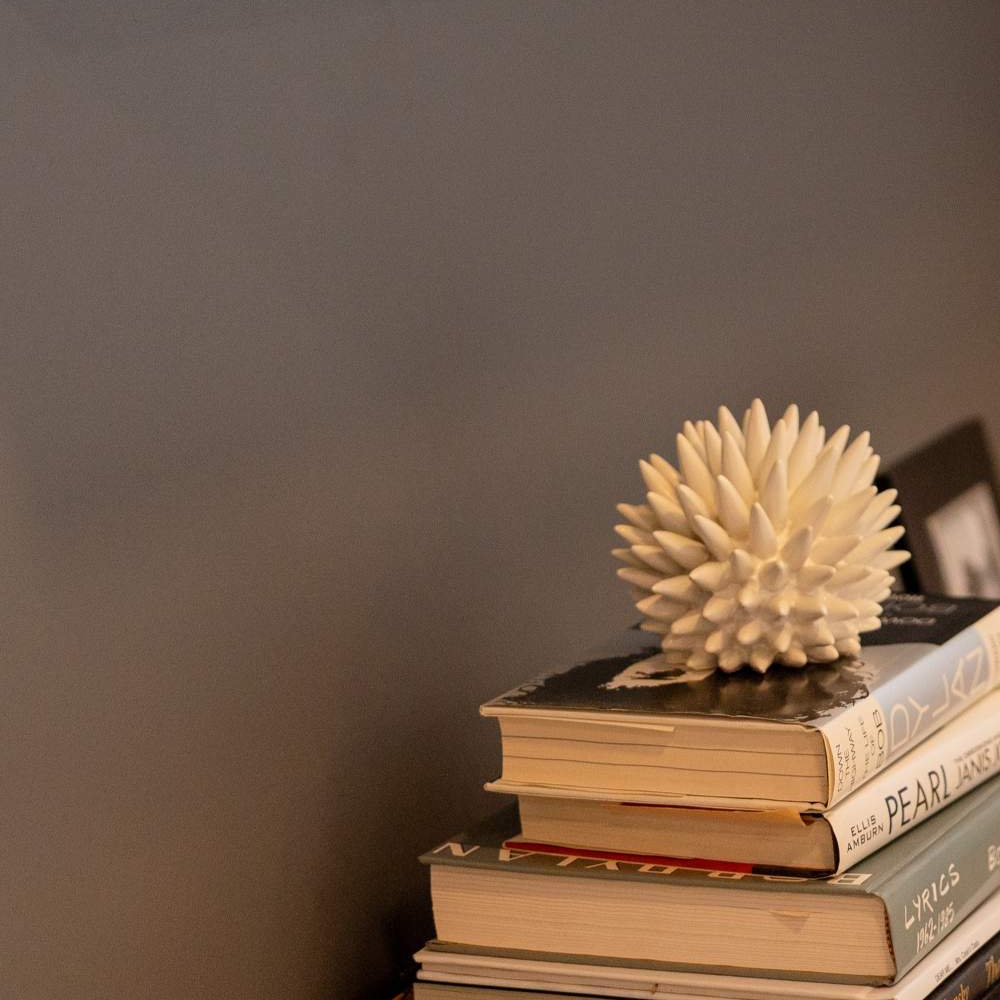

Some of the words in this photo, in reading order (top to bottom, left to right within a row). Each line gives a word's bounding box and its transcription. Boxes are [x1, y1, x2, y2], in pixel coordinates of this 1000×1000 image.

[872, 709, 885, 769] BOB
[954, 753, 992, 789] JANIS
[850, 814, 876, 837] ELLIS
[885, 764, 951, 835] PEARL
[847, 823, 884, 853] AMBURN
[904, 863, 960, 930] LYRICS
[916, 901, 956, 953] 1962-1985
